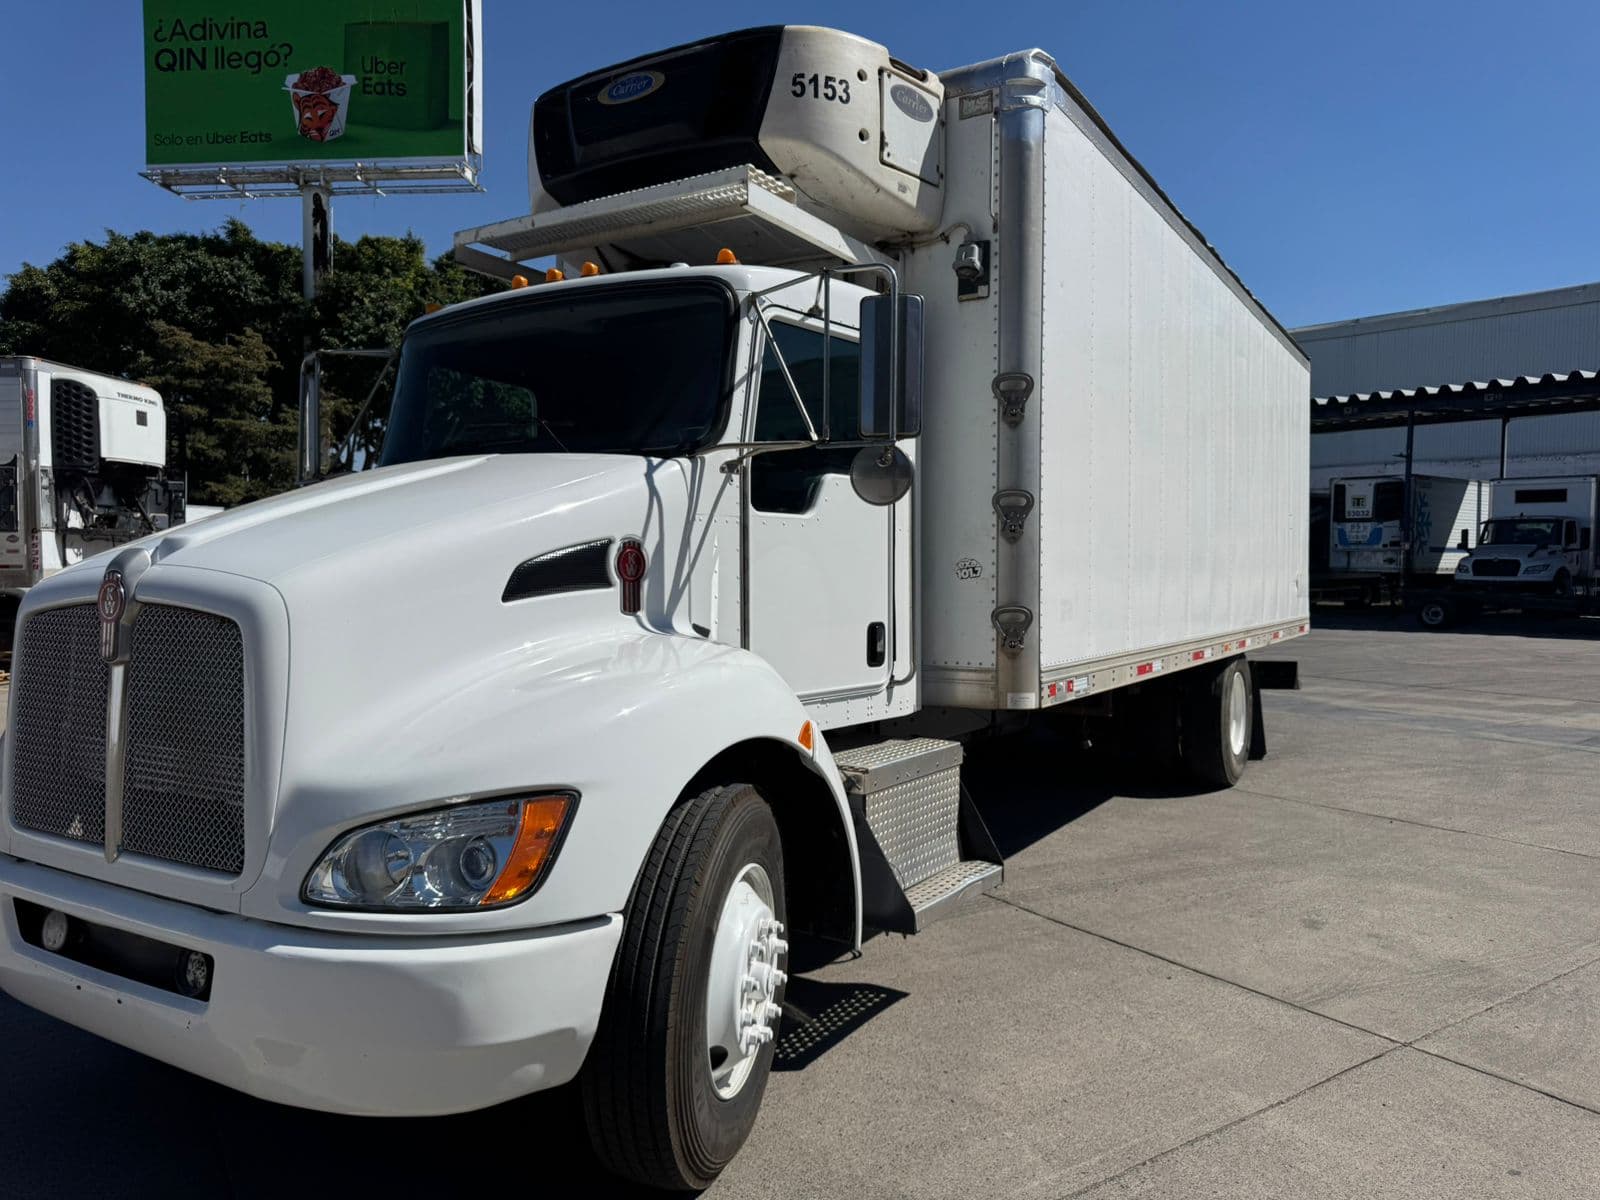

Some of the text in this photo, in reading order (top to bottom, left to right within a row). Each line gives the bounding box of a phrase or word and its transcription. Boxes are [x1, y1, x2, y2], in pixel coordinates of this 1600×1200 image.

[153, 16, 268, 43] ¿Adivina
[154, 42, 293, 75] QIN llegó?
[361, 55, 407, 74] Uber
[362, 76, 407, 97] Eats
[612, 77, 650, 97] Carrier
[791, 72, 851, 105] 5153
[896, 89, 928, 114] Carrier
[153, 130, 273, 146] Solo en Uber Eats
[954, 566, 982, 579] 101.7
